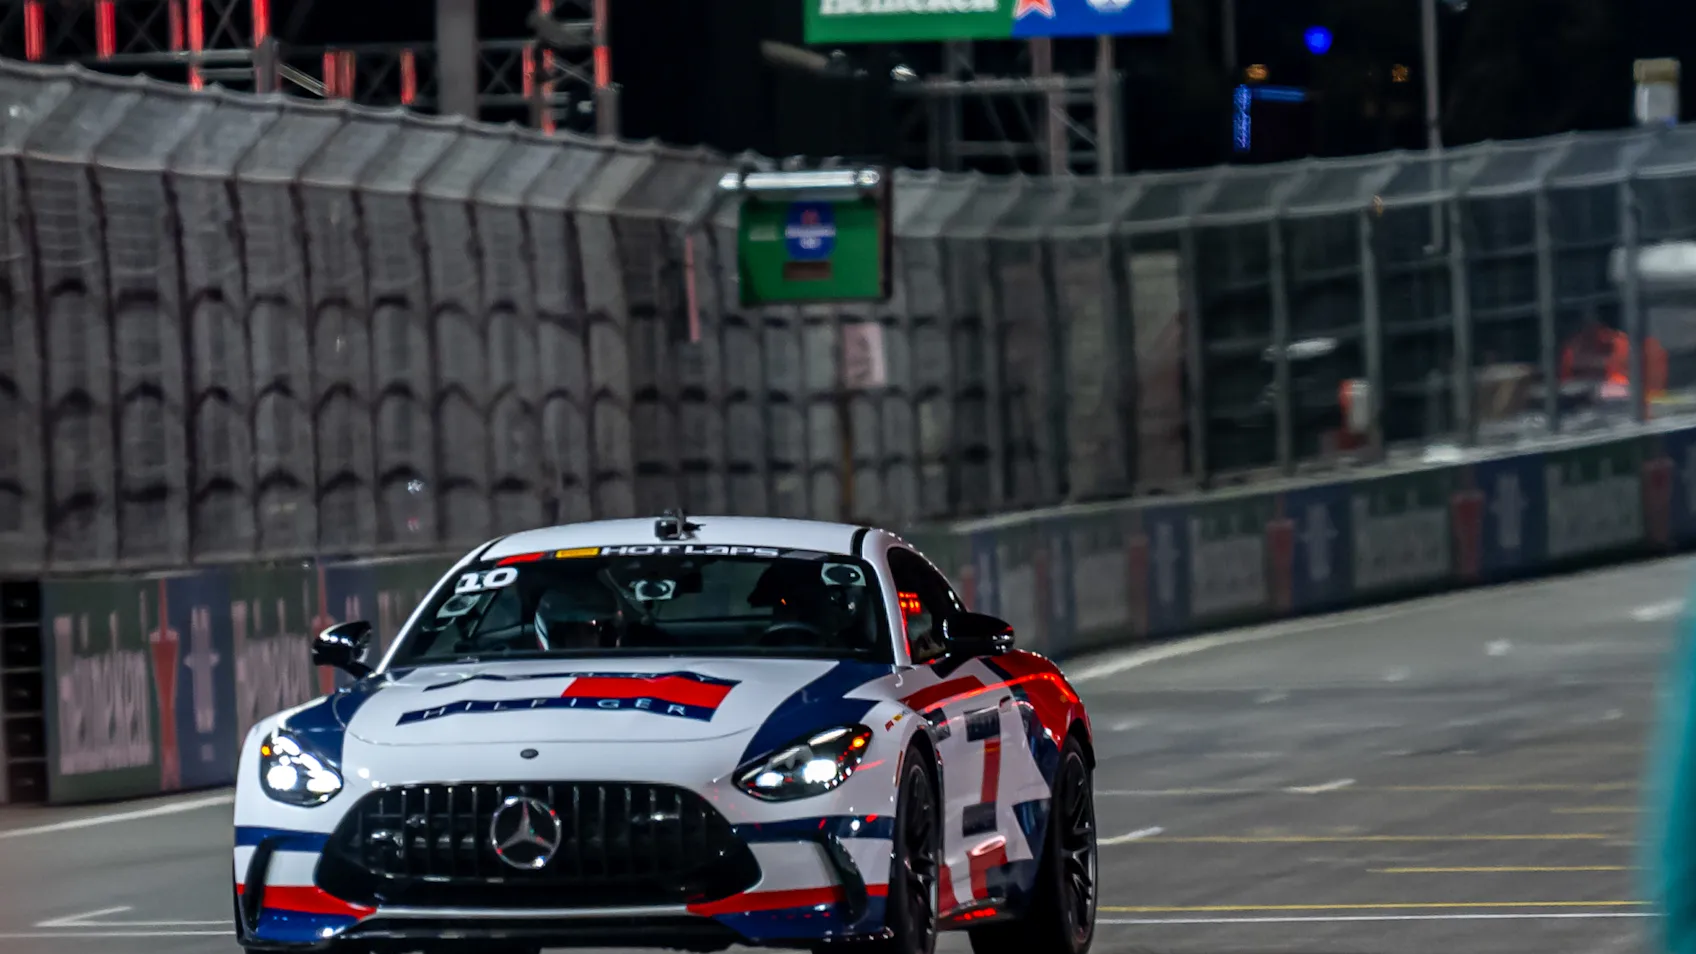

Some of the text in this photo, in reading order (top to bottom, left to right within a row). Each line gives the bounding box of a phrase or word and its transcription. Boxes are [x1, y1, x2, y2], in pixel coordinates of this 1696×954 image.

[600, 545, 680, 556] HOT
[455, 566, 518, 594] 10
[422, 697, 686, 719] HILFIGER
